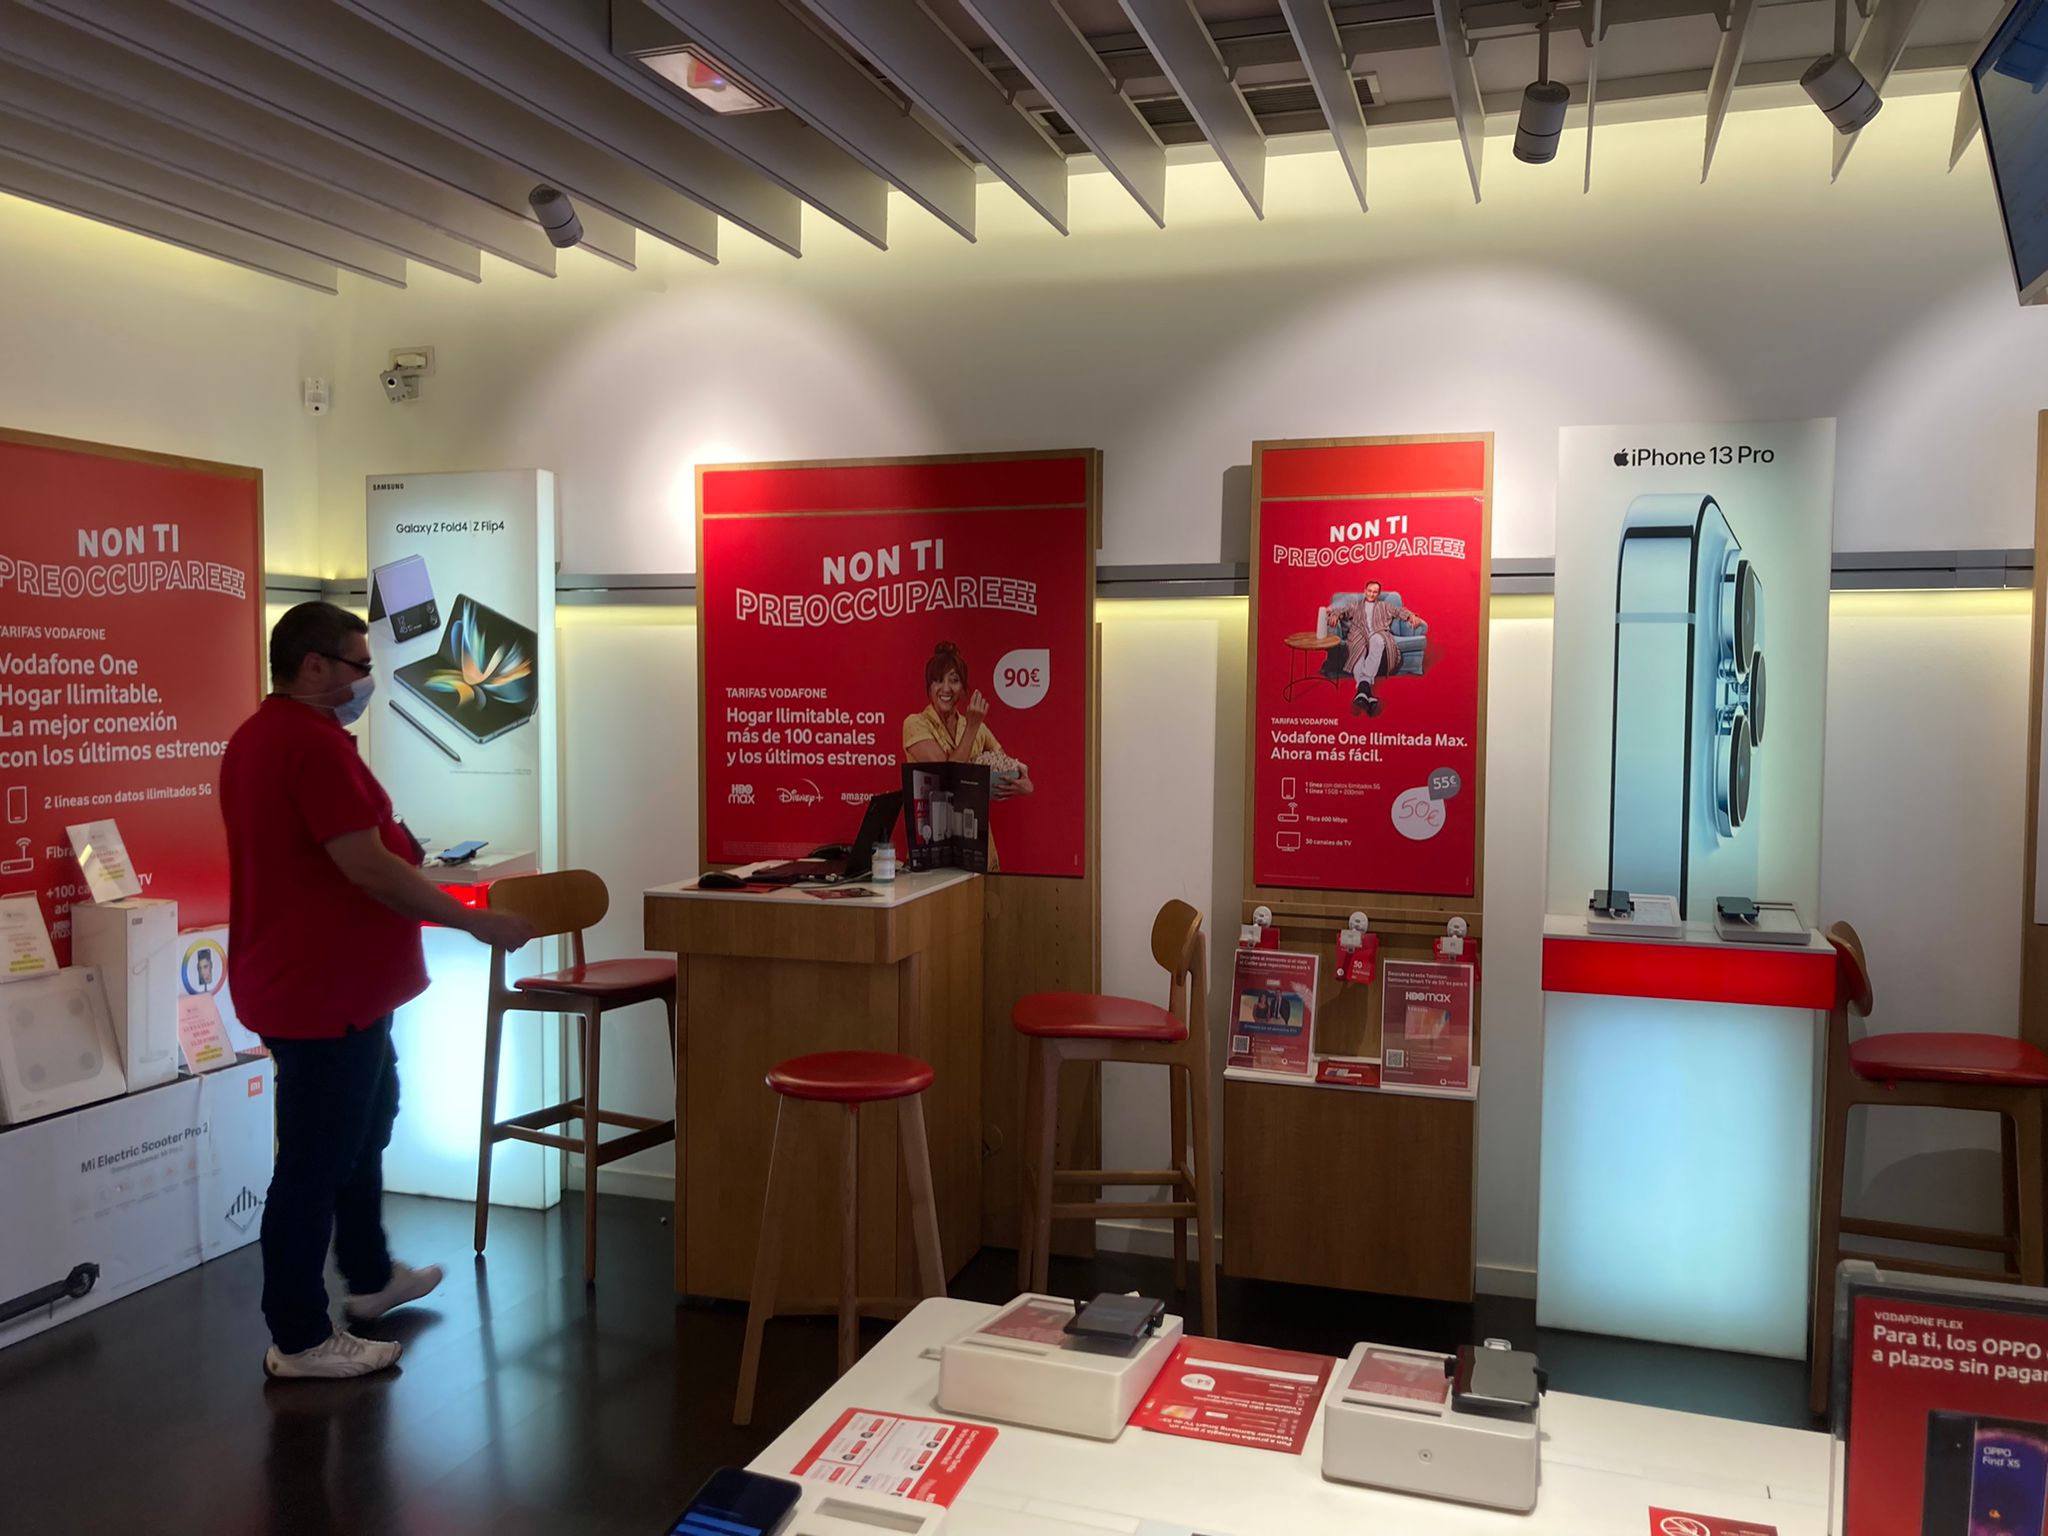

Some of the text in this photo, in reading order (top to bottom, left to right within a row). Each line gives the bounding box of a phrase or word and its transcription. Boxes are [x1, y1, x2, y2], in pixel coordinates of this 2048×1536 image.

[1632, 446, 1774, 466] iPhone 13 Pro
[373, 483, 404, 491] SAMSUNG
[396, 520, 505, 535] Galaxy Z Fold4 Z Flip4
[1330, 515, 1408, 543] NON TI
[78, 524, 179, 557] NON TI
[823, 538, 944, 585] NON TI
[44, 626, 106, 641] VODAFONE
[0, 653, 138, 675] Vodafone One
[1003, 667, 1041, 688] 90€
[0, 683, 163, 711] Hogar Ilimitable.
[726, 687, 827, 699] TARIFAS VODAFONE
[0, 711, 177, 740] La mejor conexión
[726, 708, 885, 726] Hogar Ilimitable, con
[1299, 718, 1338, 726] VODAFONE
[727, 728, 875, 746] más de 100 canales
[1271, 731, 1468, 747] Vodafone One Ilimitada Max.
[0, 741, 228, 768] con los últimos estrenos
[726, 747, 896, 767] y los últimos estrenos
[1271, 747, 1383, 762] Ahora más fácil.
[1433, 775, 1457, 789] 55€
[44, 783, 212, 809] 2 líneas con datos ilimitados 5G
[1399, 797, 1439, 827] 50€
[46, 884, 75, 899] +100
[81, 1158, 96, 1173] Mi
[97, 1145, 140, 1168] Electric
[141, 1133, 183, 1153] Scooter
[184, 1126, 202, 1140] Pro
[202, 1122, 209, 1133] 2
[1874, 1311, 1964, 1330] VODAFONE FLEX
[1873, 1325, 2041, 1359] Para ti, los OPPO
[1872, 1349, 1883, 1362] a
[1888, 1349, 1955, 1371] plazos
[1959, 1358, 1988, 1375] sin
[1983, 1446, 2011, 1457] OPPO
